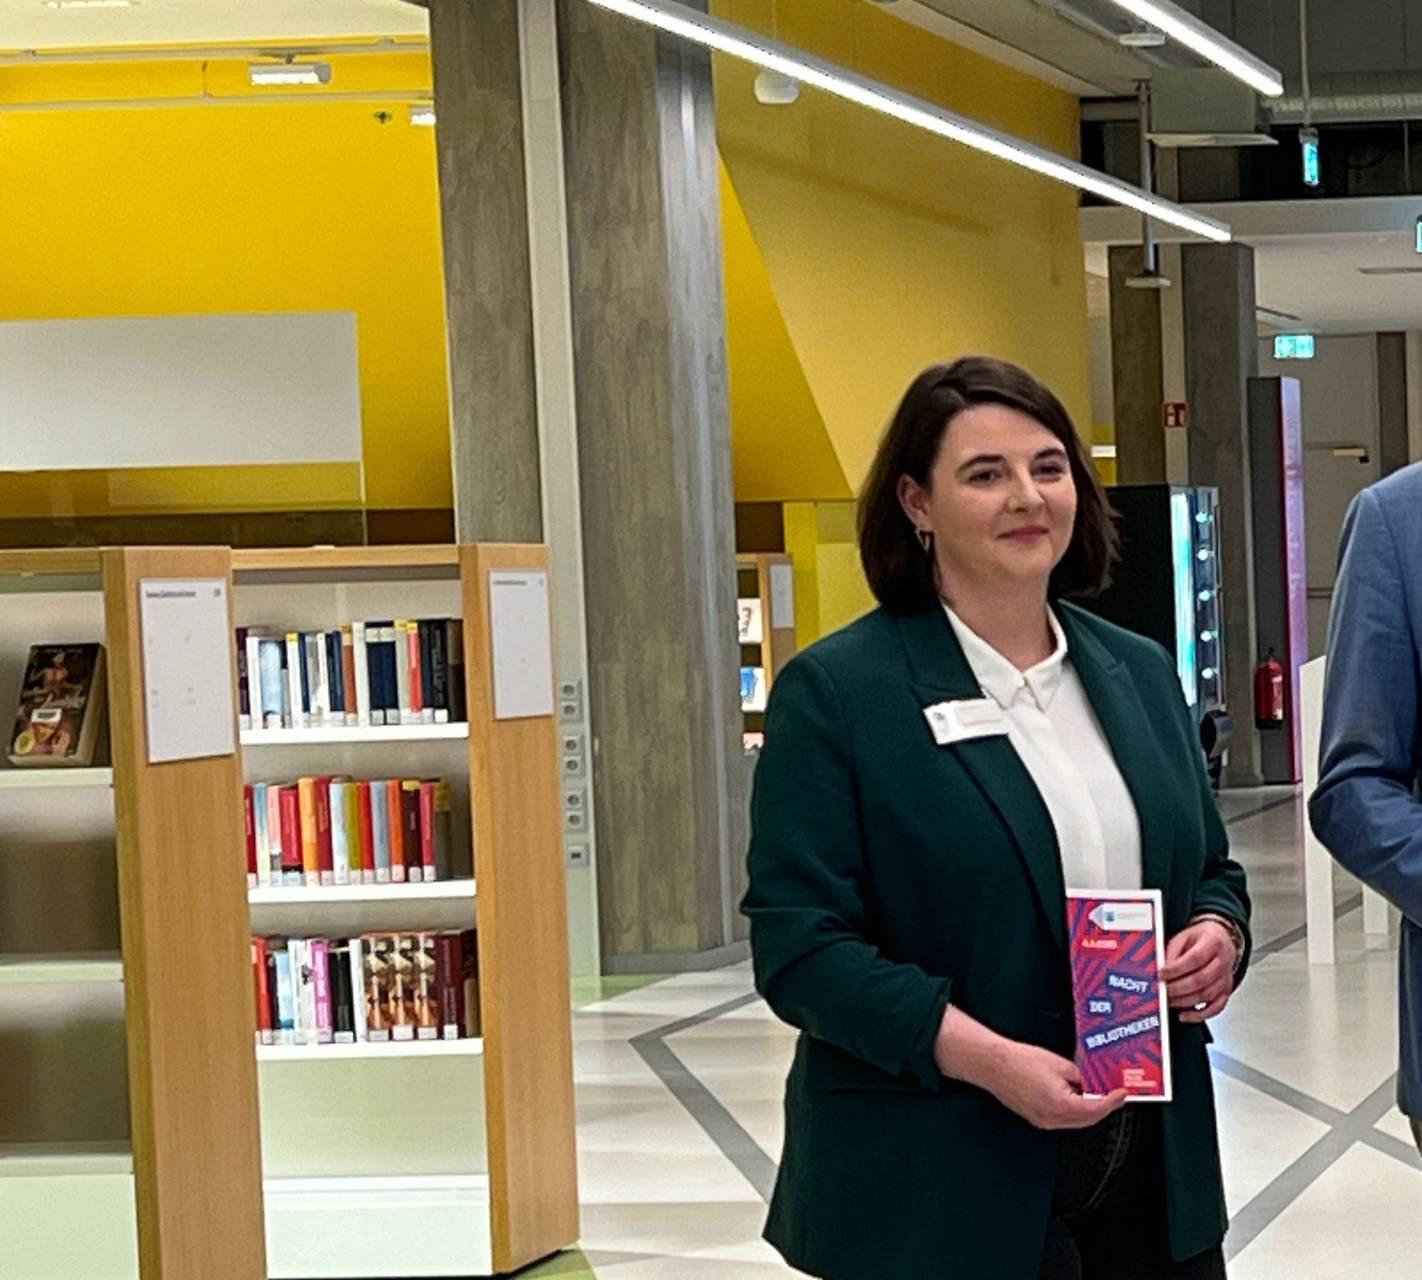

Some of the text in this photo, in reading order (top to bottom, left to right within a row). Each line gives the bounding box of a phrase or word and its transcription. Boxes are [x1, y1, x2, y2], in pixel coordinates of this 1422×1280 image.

[1108, 974, 1149, 993] NACHT
[1089, 1000, 1113, 1014] DER
[1085, 1015, 1160, 1050] BIBLIOTHEKEN
